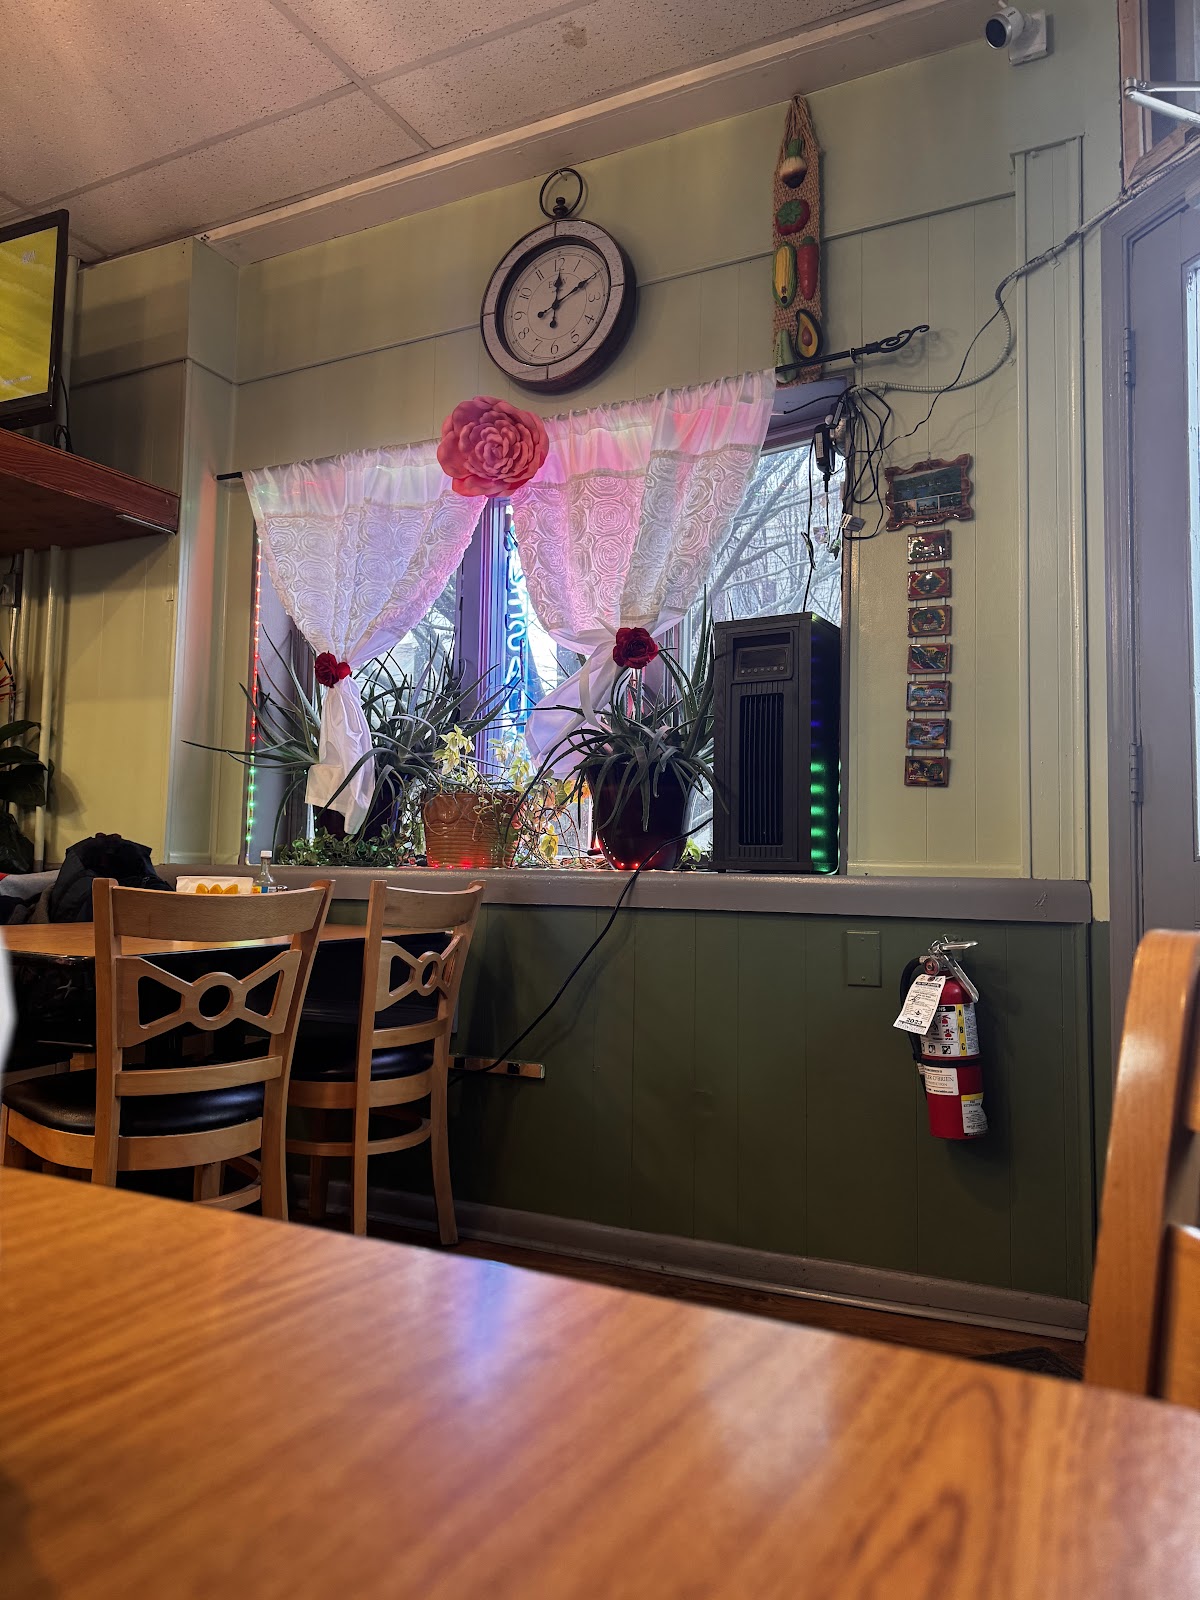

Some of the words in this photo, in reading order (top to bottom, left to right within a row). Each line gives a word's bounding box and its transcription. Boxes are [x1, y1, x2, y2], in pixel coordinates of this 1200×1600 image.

[554, 257, 566, 273] 12
[573, 259, 581, 272] 1
[535, 269, 545, 281] 11
[519, 287, 532, 300] 10
[587, 292, 601, 303] 3
[513, 311, 527, 321] 9
[584, 314, 595, 325] 4
[517, 327, 530, 340] 8
[570, 329, 580, 344] 5
[532, 338, 543, 352] 7
[550, 340, 559, 355] 6
